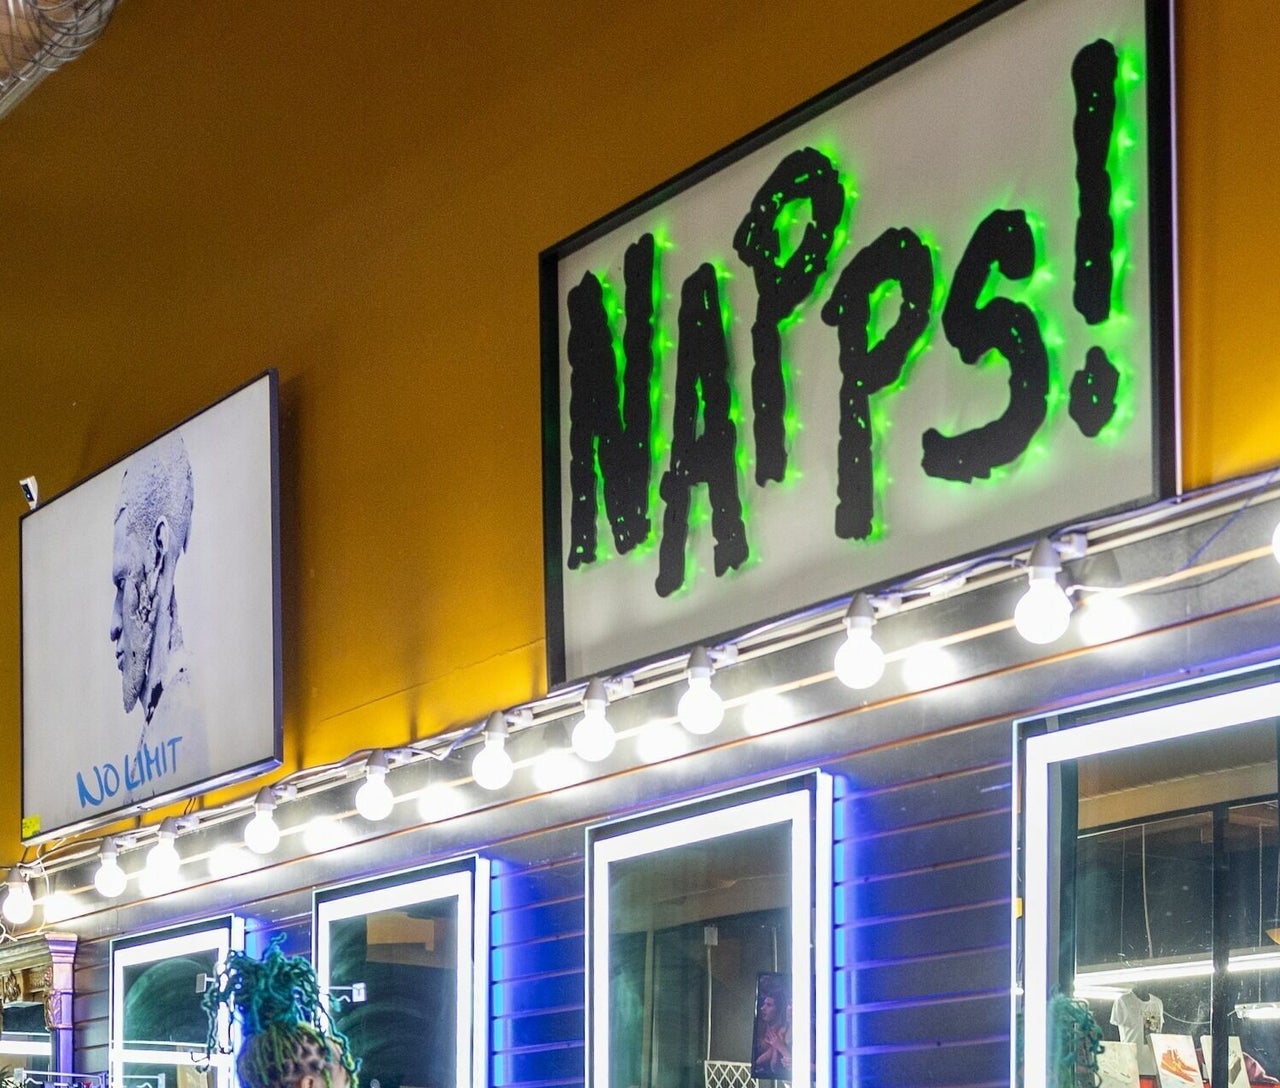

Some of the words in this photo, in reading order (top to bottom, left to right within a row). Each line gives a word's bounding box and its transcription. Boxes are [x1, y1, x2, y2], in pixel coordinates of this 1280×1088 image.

[567, 38, 1120, 598] NAPPS!
[76, 763, 120, 808] NO
[124, 736, 183, 791] LIMIT
